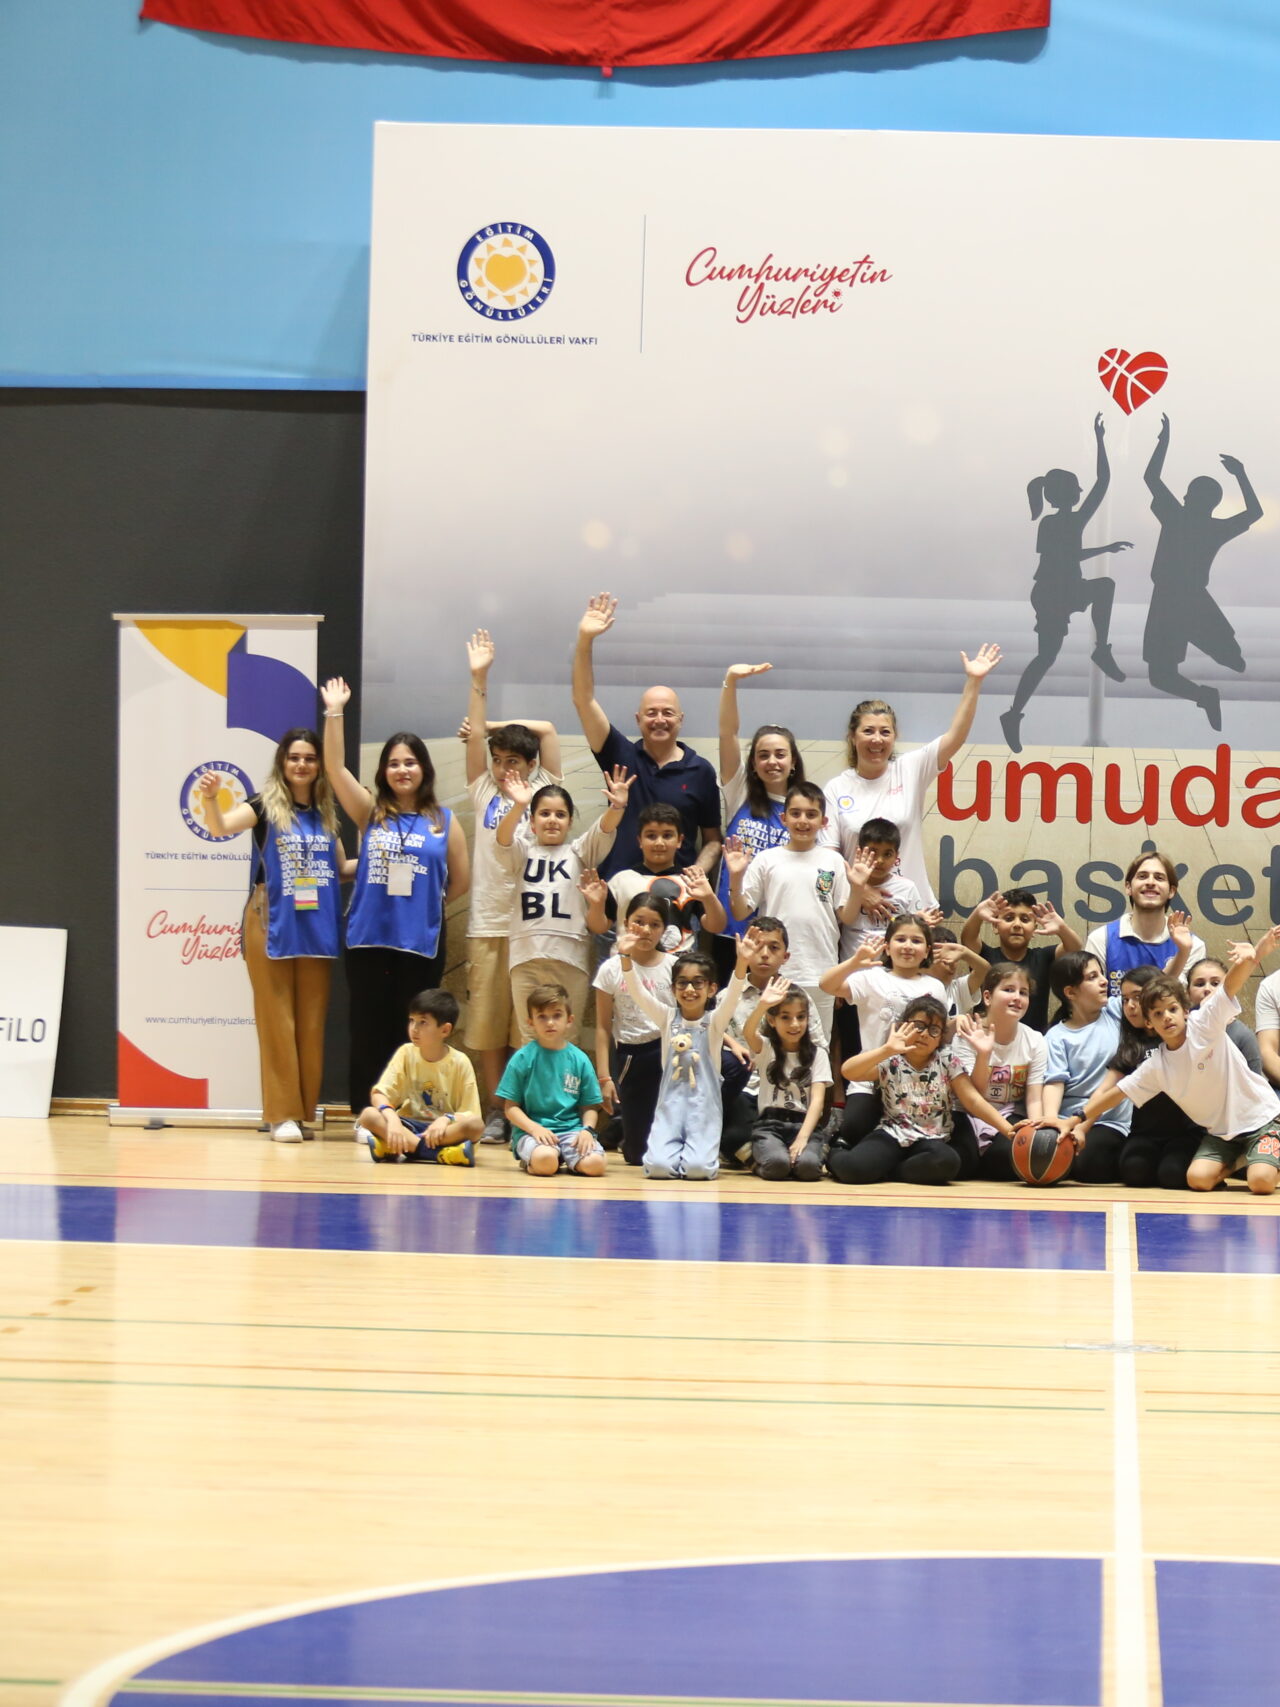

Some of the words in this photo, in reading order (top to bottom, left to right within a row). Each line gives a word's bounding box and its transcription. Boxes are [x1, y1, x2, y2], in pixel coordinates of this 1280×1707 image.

[476, 223, 535, 244] EĞİTİM
[685, 246, 893, 298] Cumhuriyetin
[459, 278, 553, 320] GÖNÜLLÜLERİ
[736, 282, 844, 324] Yüzleri
[412, 333, 454, 343] TÜRKİYE
[458, 333, 493, 344] EĞİTİM
[496, 334, 565, 345] GÖNÜLLÜLERİ
[569, 336, 598, 345] VAKFI
[145, 851, 178, 860] TÜRKİYE
[181, 851, 208, 861] EĞİTİM
[211, 852, 253, 862] GÖNÜLLÜL
[523, 858, 571, 883] UK
[521, 892, 571, 921] BL
